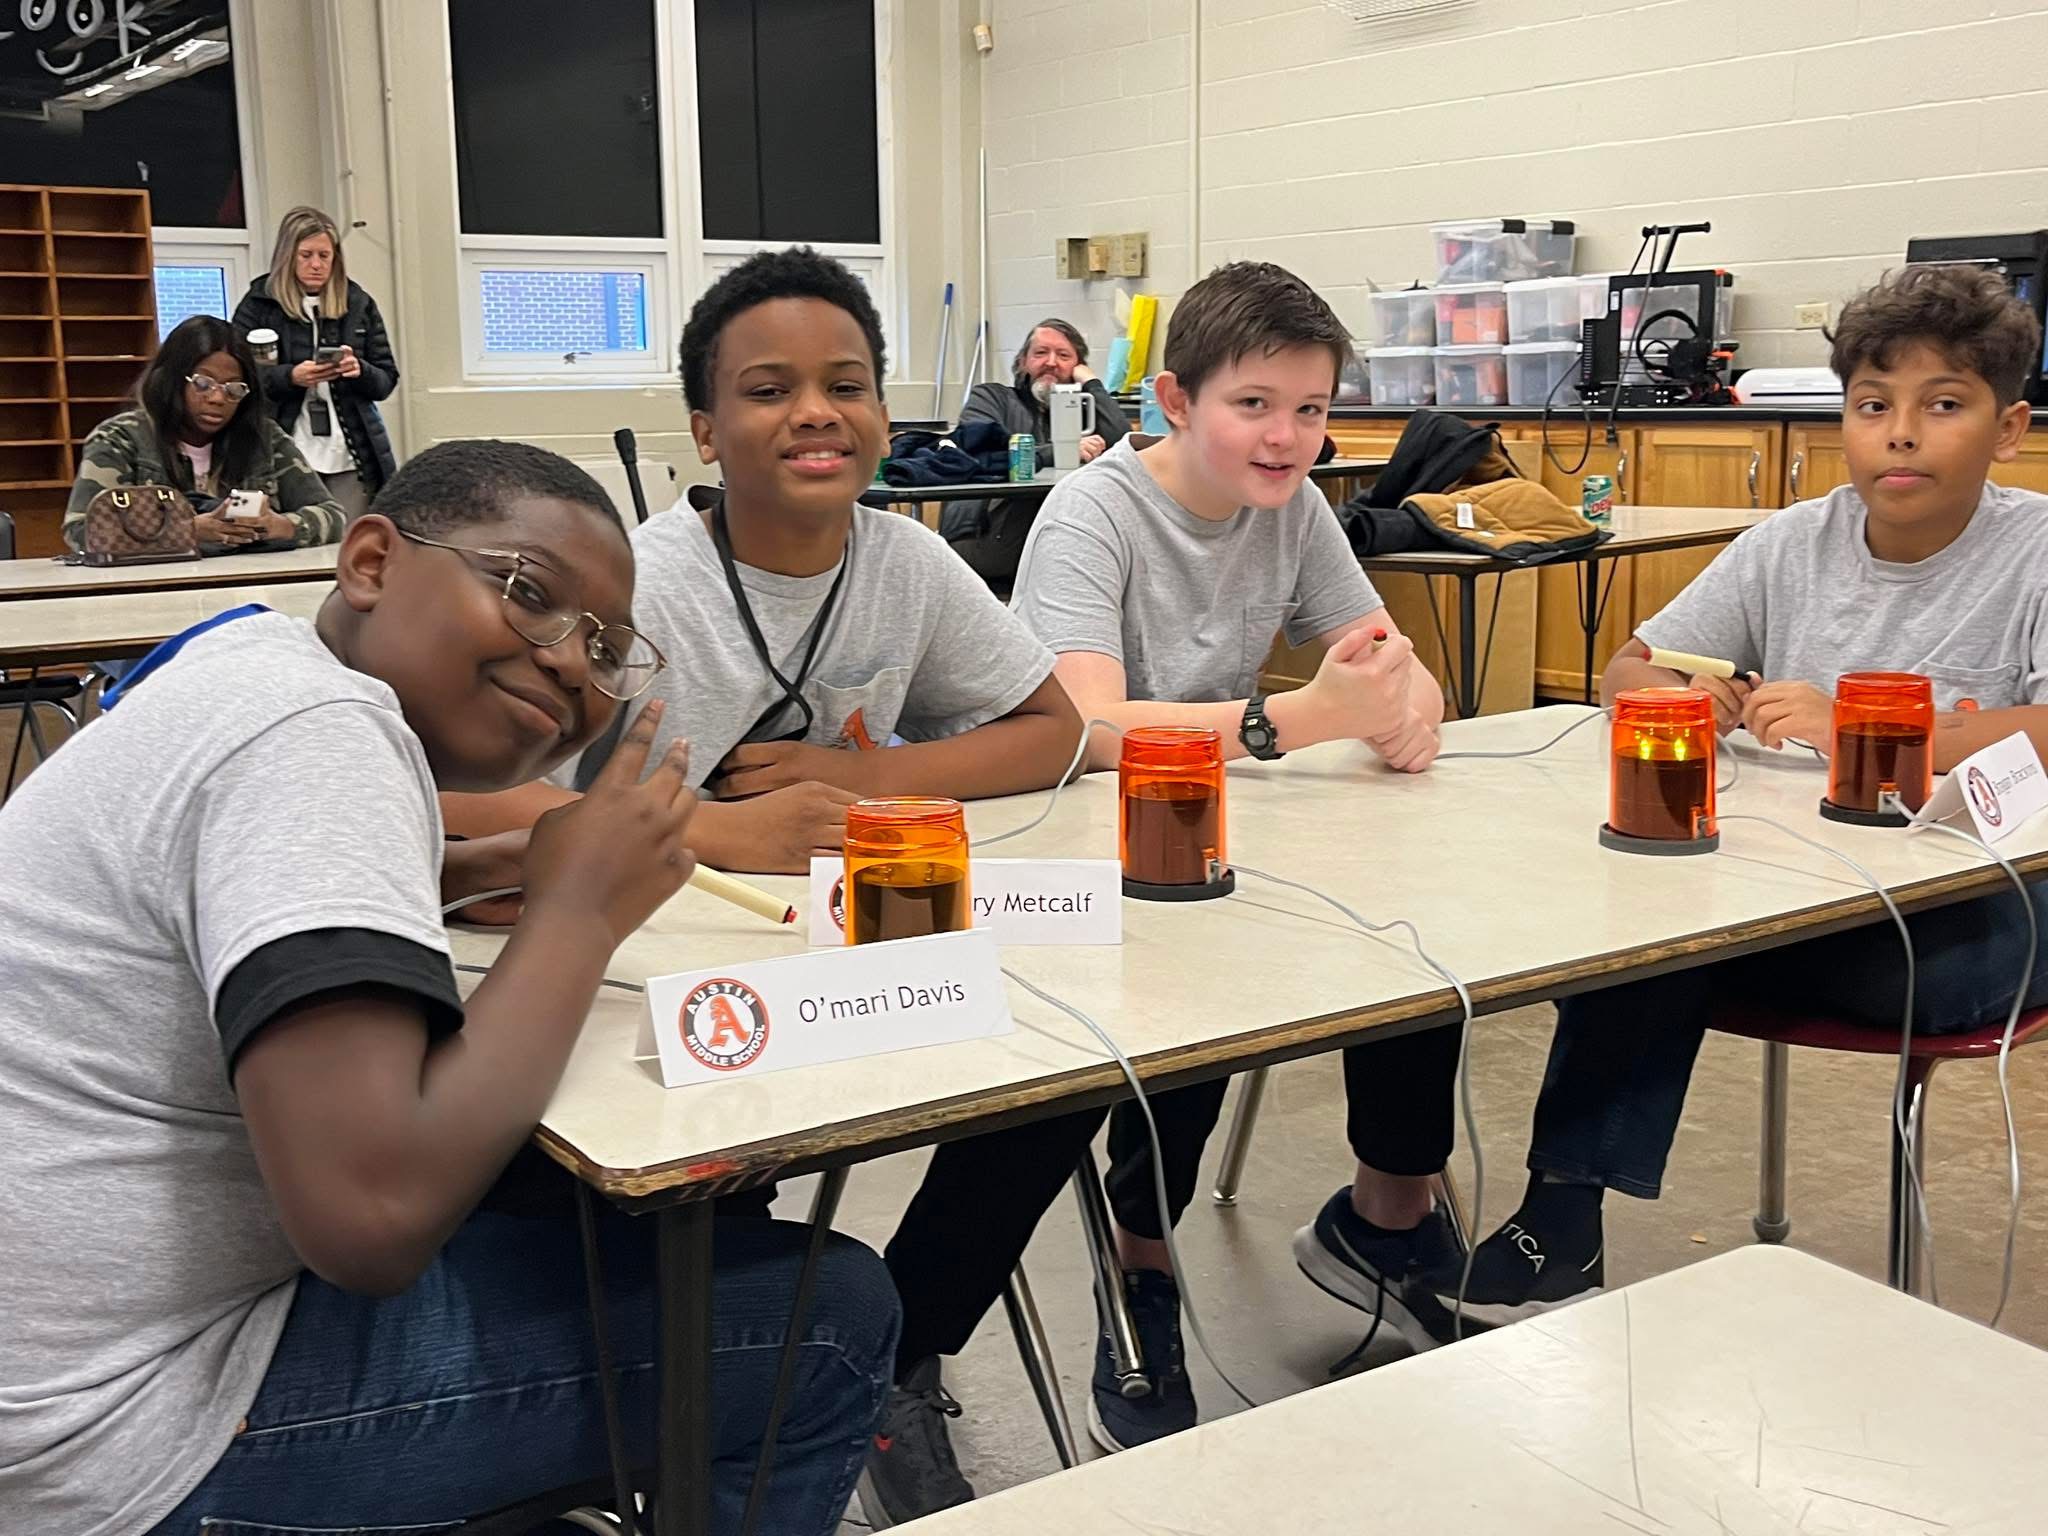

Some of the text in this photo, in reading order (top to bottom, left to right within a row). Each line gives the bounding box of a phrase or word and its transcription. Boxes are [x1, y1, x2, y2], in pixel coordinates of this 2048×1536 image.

[0, 0, 151, 57] ook
[973, 892, 1094, 917] ry Metcalf
[686, 982, 757, 1015] AUSTIN
[798, 979, 966, 1023] O'mari Davis
[707, 995, 752, 1049] A
[686, 1024, 766, 1066] MIDDLE SCHOOL
